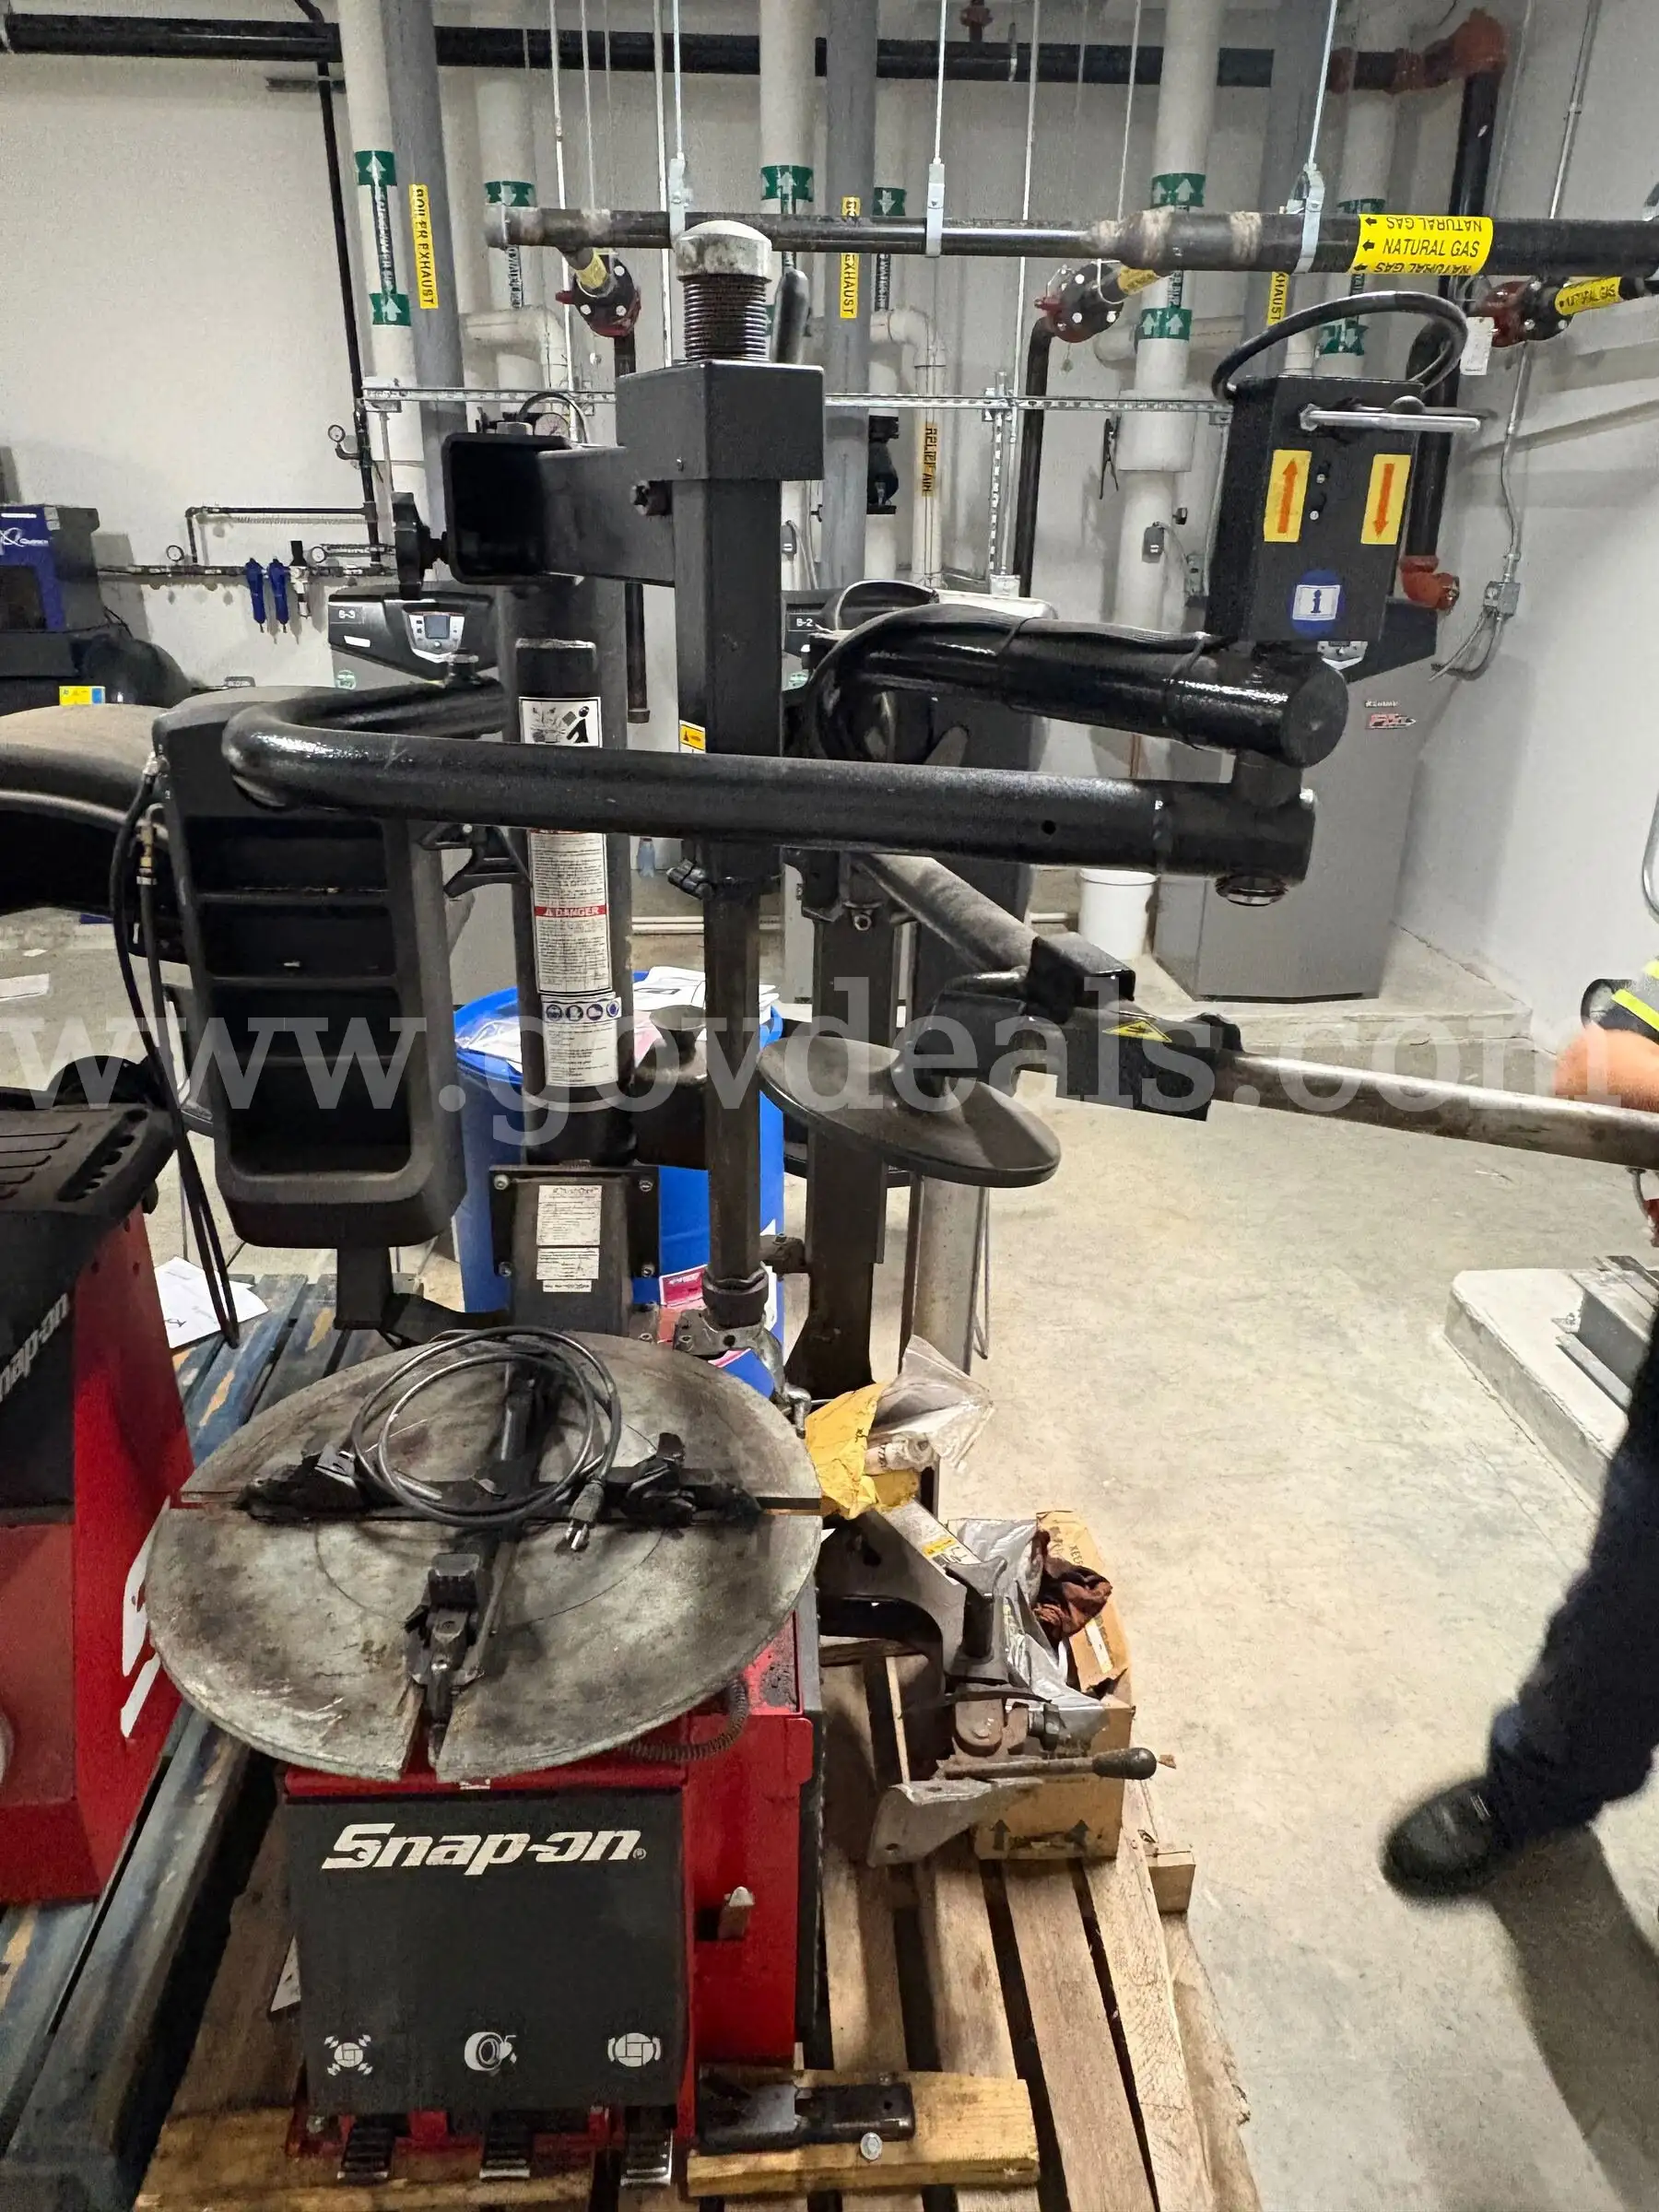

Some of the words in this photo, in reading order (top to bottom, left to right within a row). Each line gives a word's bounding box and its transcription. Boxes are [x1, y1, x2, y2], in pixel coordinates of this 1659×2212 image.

[1386, 217, 1415, 230] GAS
[1418, 218, 1483, 232] NATURAL
[1382, 238, 1446, 256] NATURAL
[1451, 240, 1480, 258] GAS
[843, 253, 856, 314] EXHAUST
[1270, 271, 1287, 322] XHAUST
[555, 907, 599, 917] DANGER
[0, 1292, 70, 1403] nap-on
[322, 1822, 641, 1877] Snap-on
